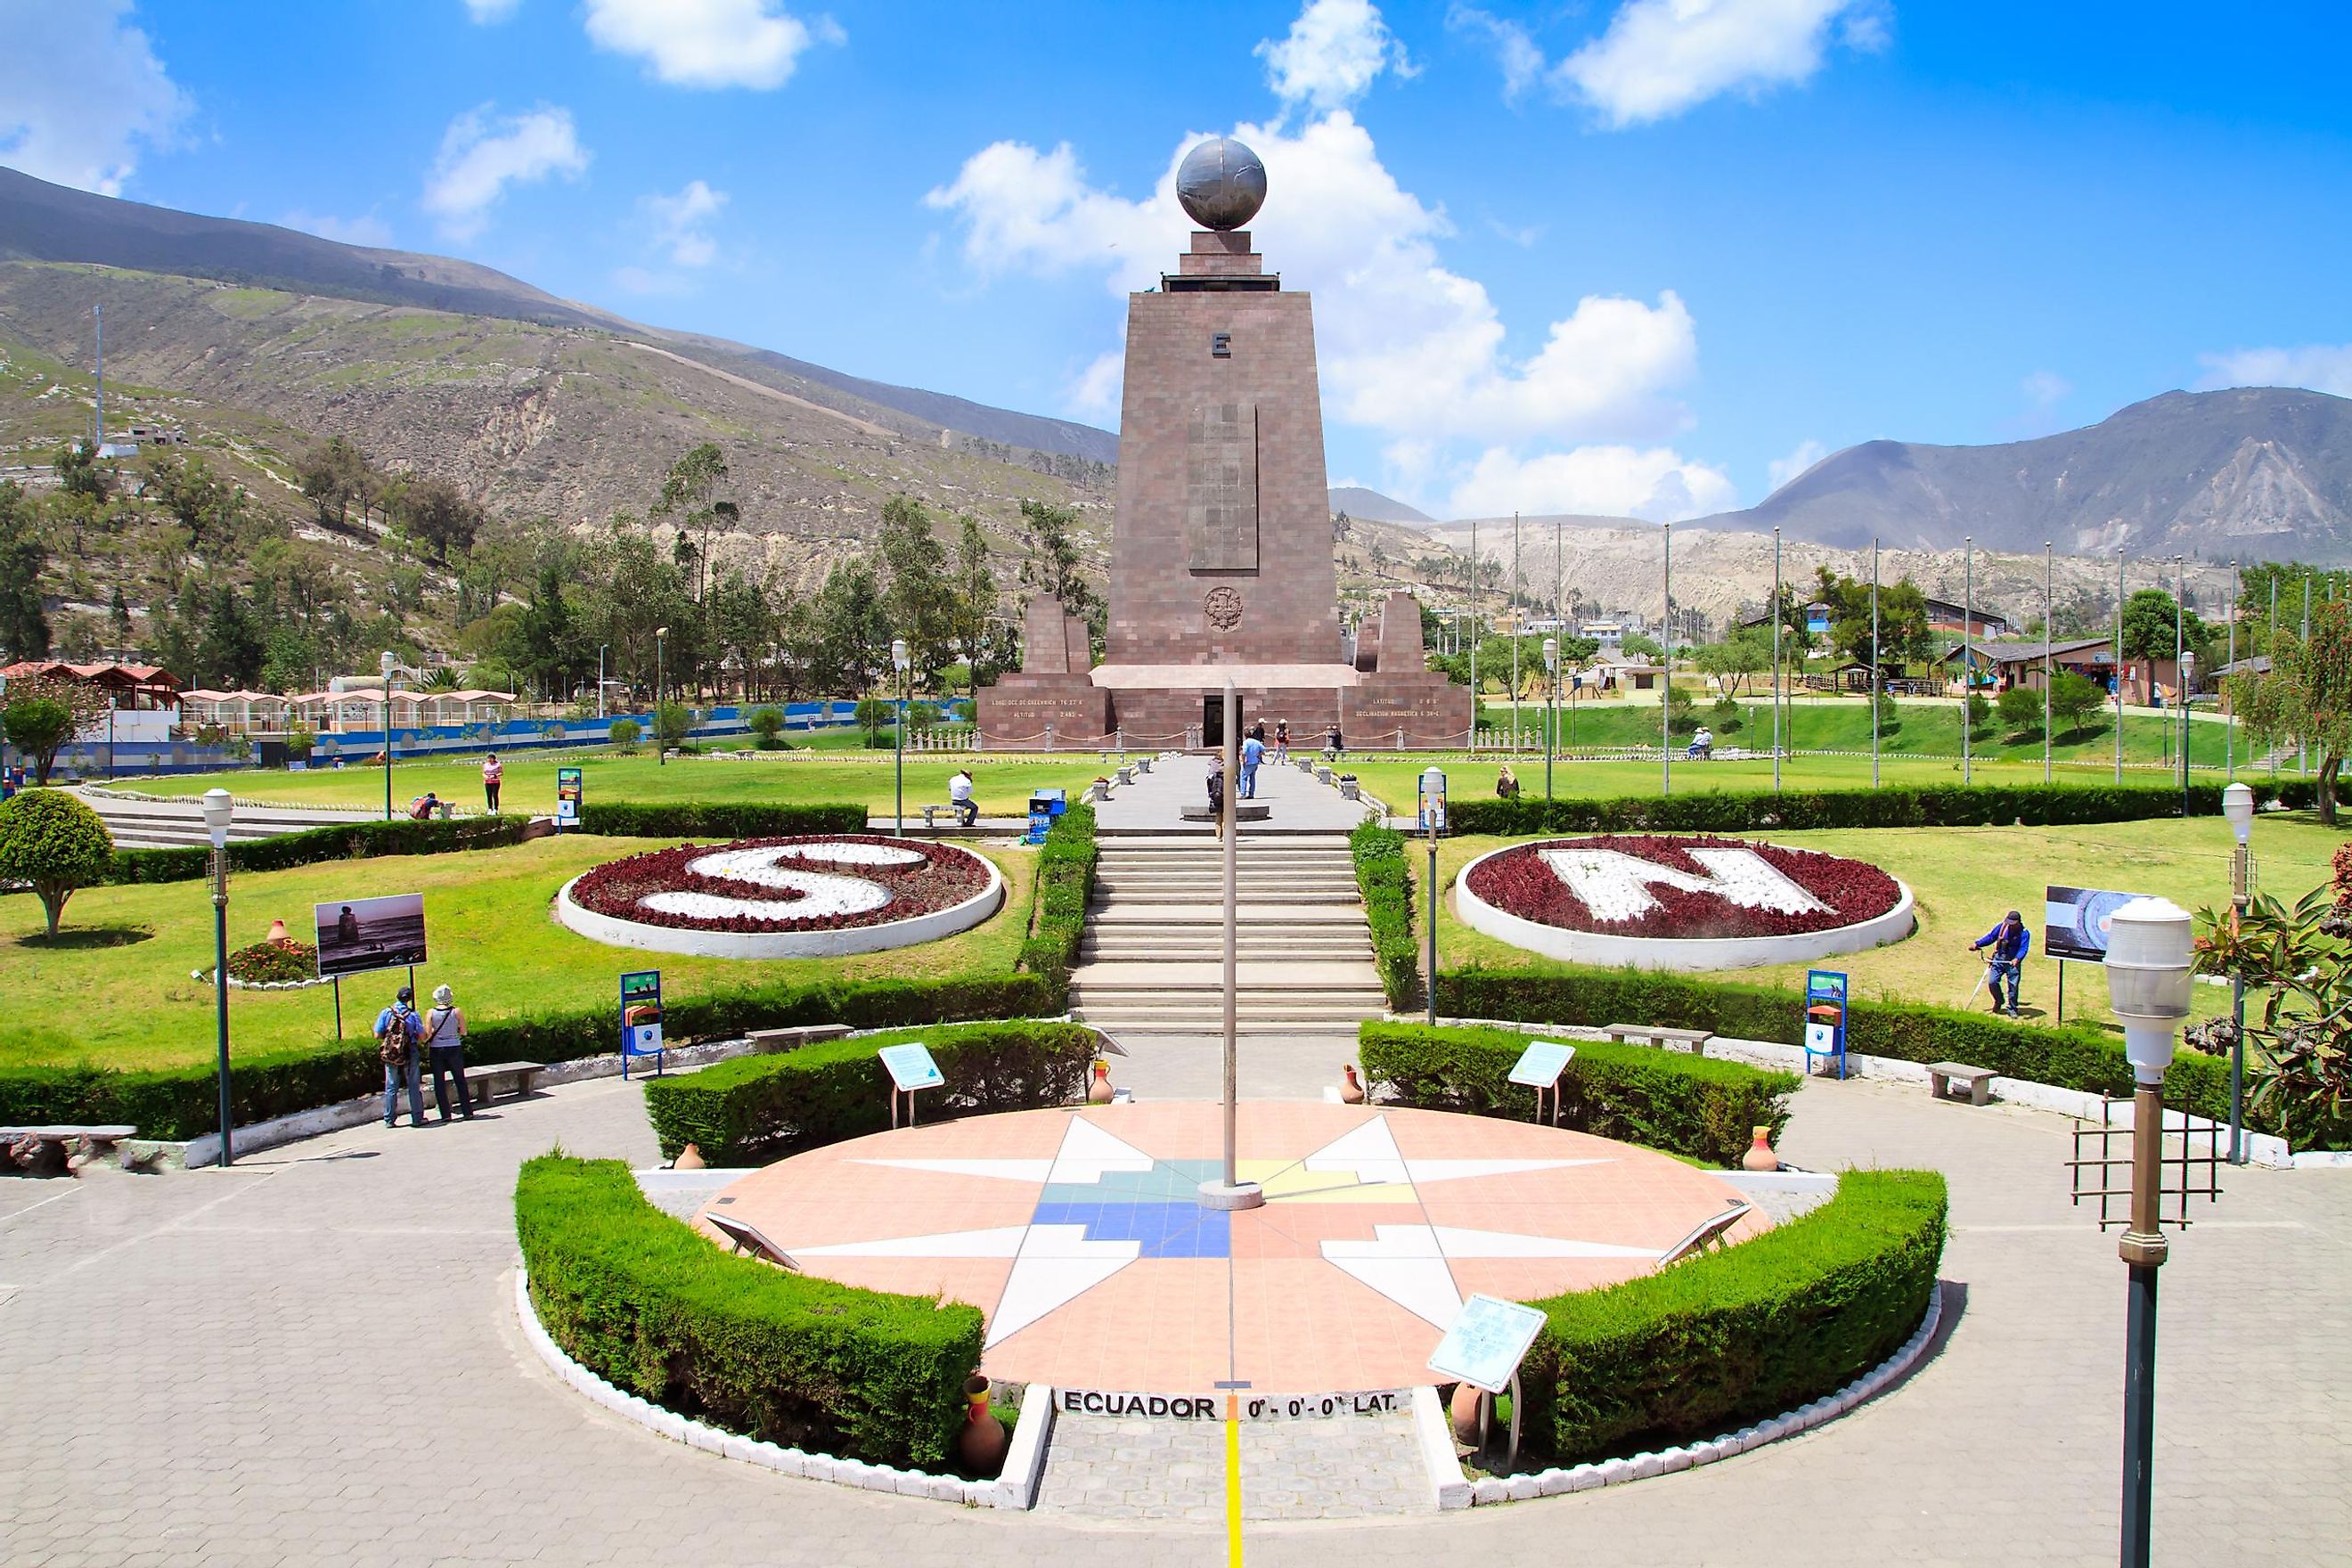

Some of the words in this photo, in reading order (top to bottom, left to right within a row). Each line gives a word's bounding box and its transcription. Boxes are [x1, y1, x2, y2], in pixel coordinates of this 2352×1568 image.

[1212, 332, 1231, 357] E
[636, 843, 928, 920] S
[1538, 847, 1840, 922] N
[1065, 1391, 1216, 1418] ECUADOR
[1354, 1394, 1397, 1413] LAT.
